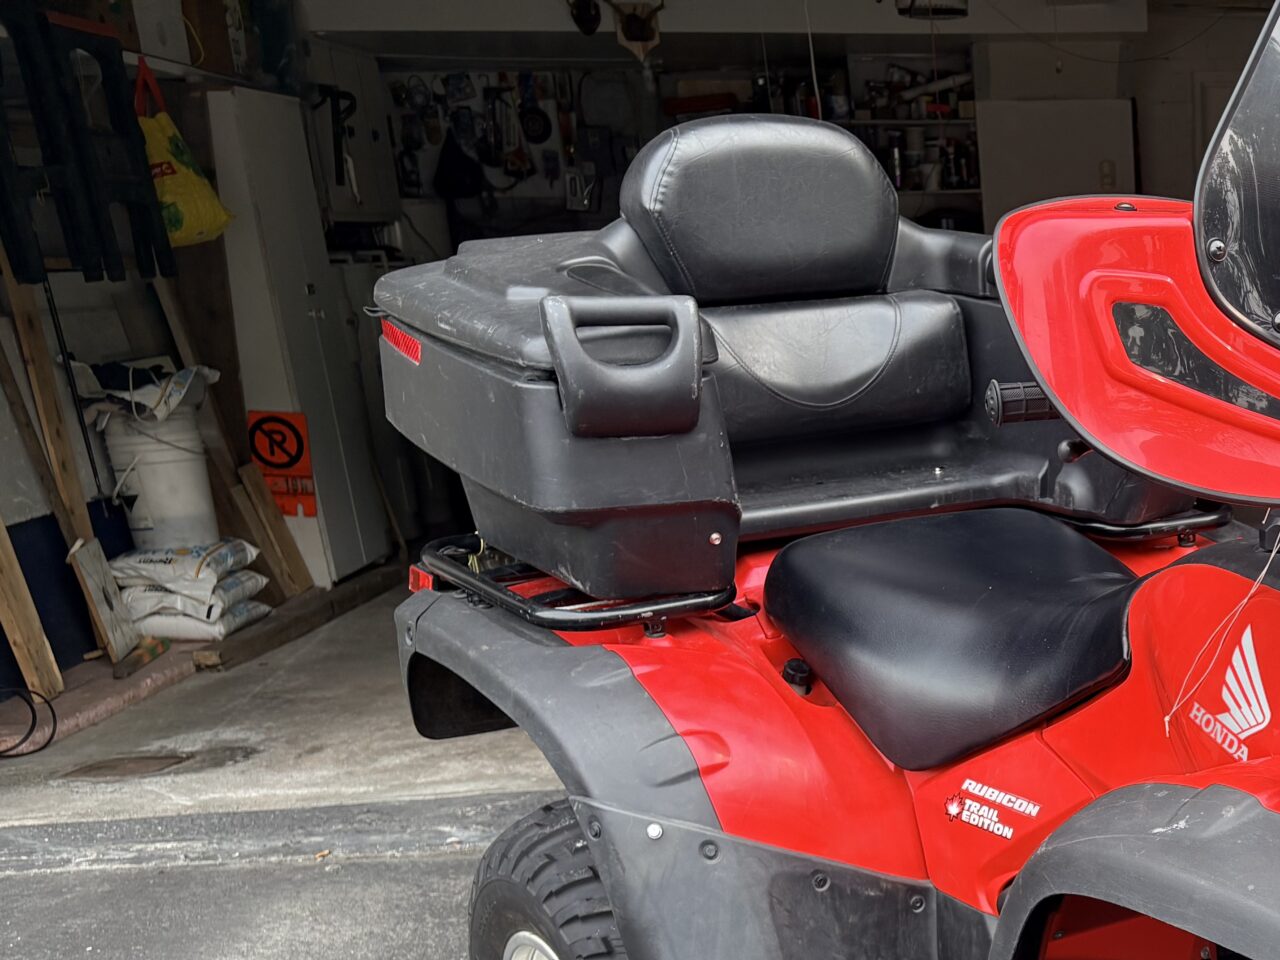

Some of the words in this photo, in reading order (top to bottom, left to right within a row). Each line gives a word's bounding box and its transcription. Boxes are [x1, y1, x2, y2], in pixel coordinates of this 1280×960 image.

[1189, 701, 1249, 762] HONDA
[961, 778, 1041, 817] RUBICON
[964, 798, 999, 822] TRAIL
[961, 810, 1013, 840] EDITION
